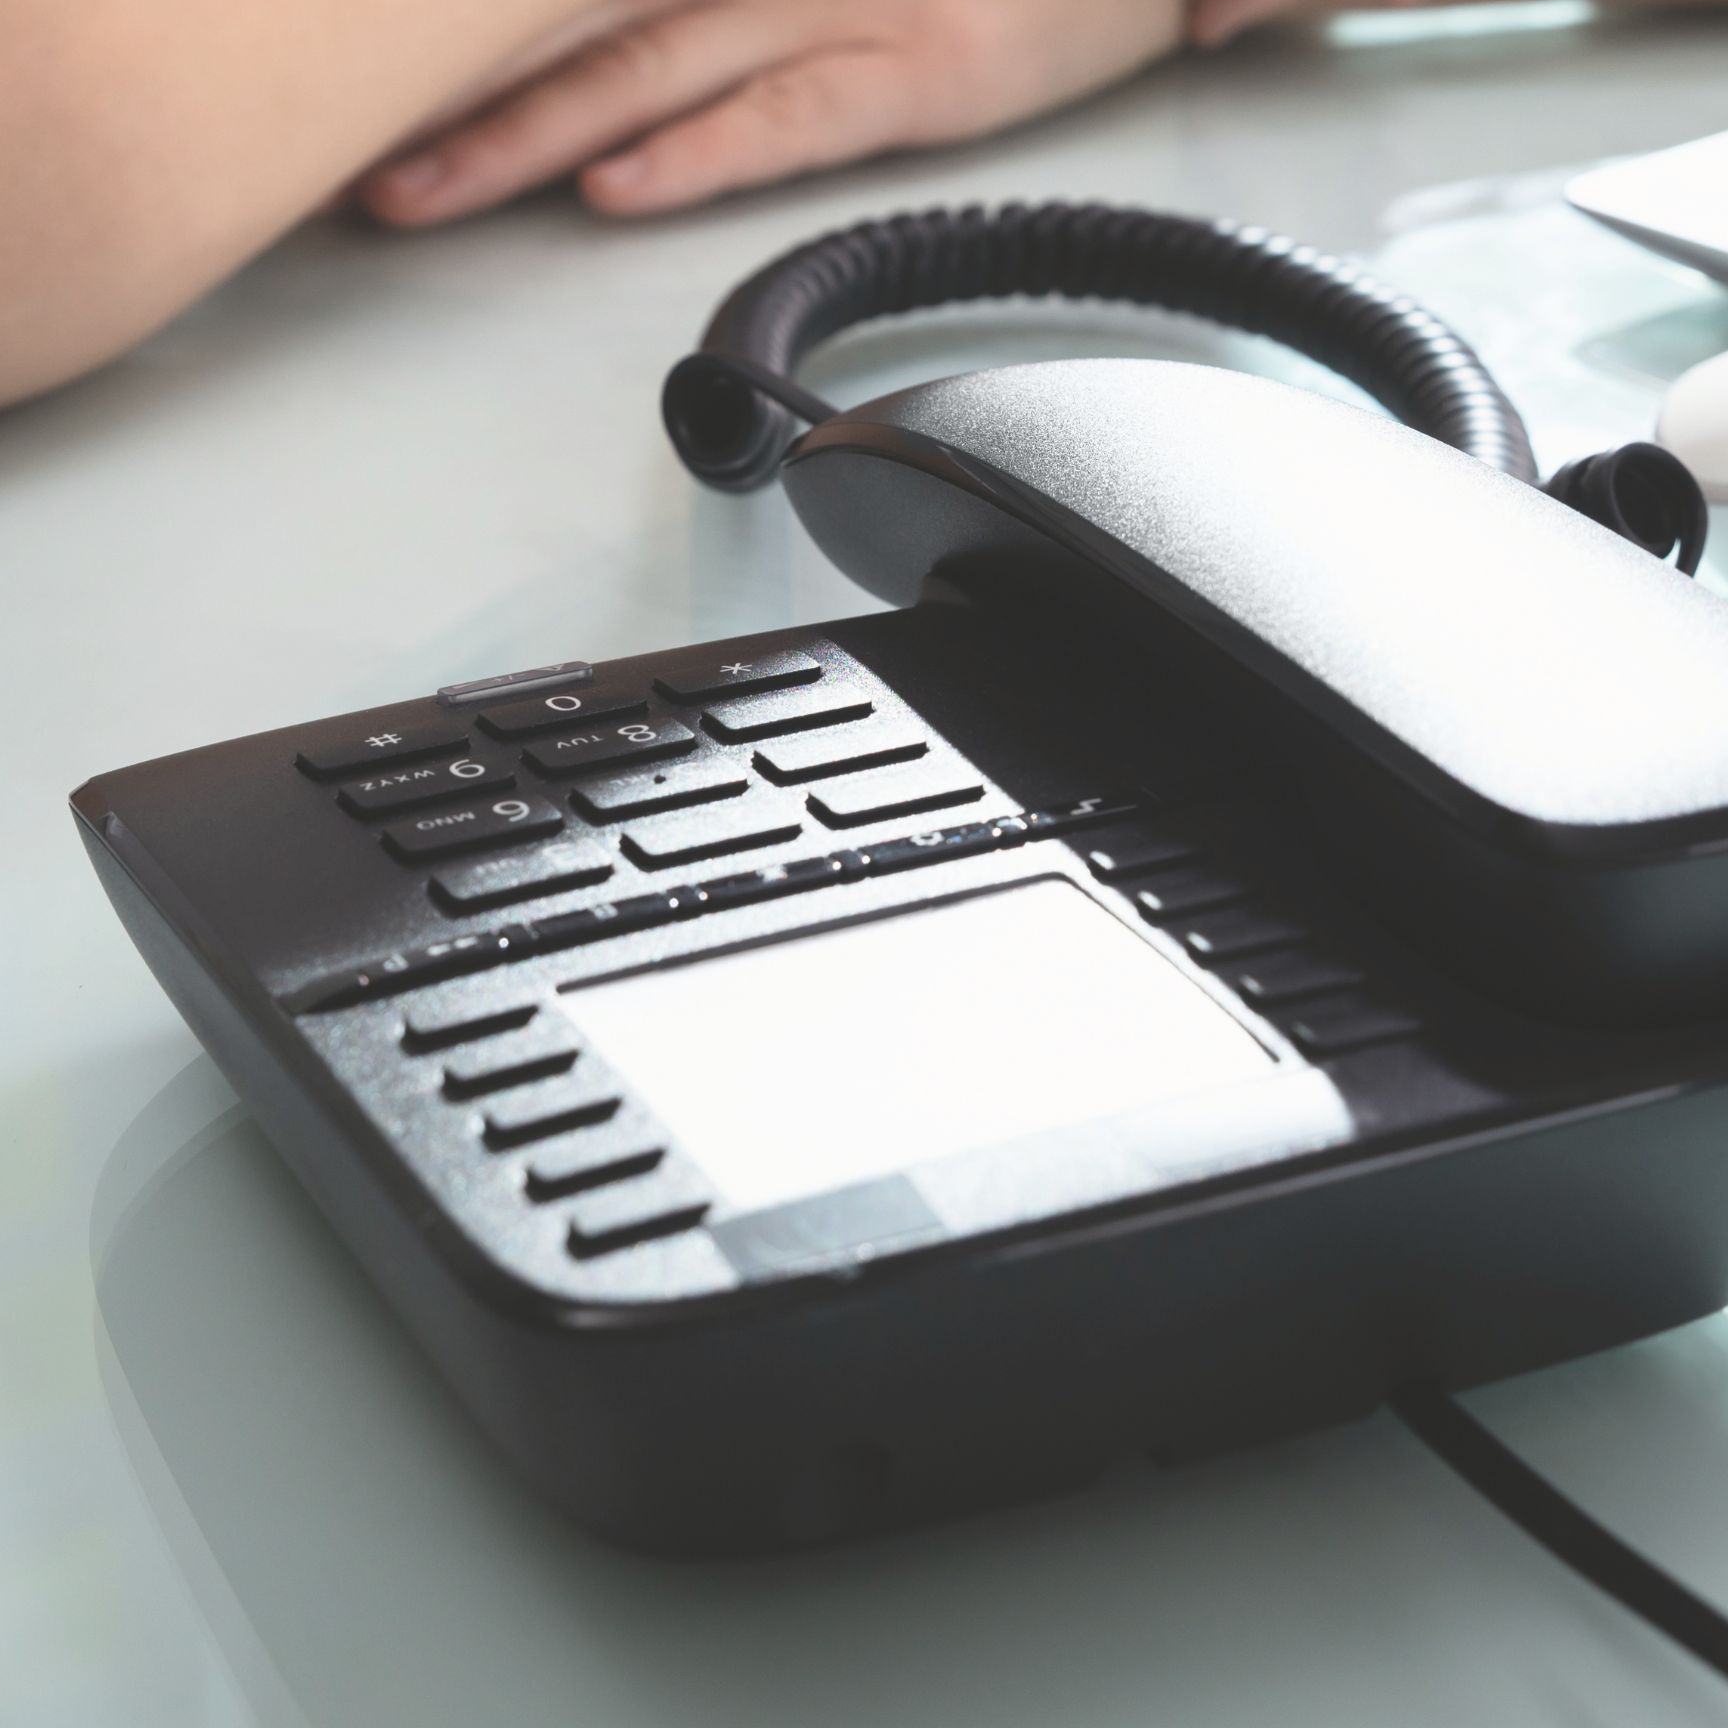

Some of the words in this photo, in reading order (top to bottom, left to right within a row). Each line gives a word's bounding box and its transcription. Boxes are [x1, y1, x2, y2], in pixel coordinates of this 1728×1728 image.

[364, 733, 402, 747] #
[556, 734, 604, 750] TUV
[617, 724, 657, 742] 8
[449, 758, 485, 778] 9
[360, 769, 436, 791] WXYZ
[416, 811, 476, 831] MNO
[492, 800, 530, 822] 6
